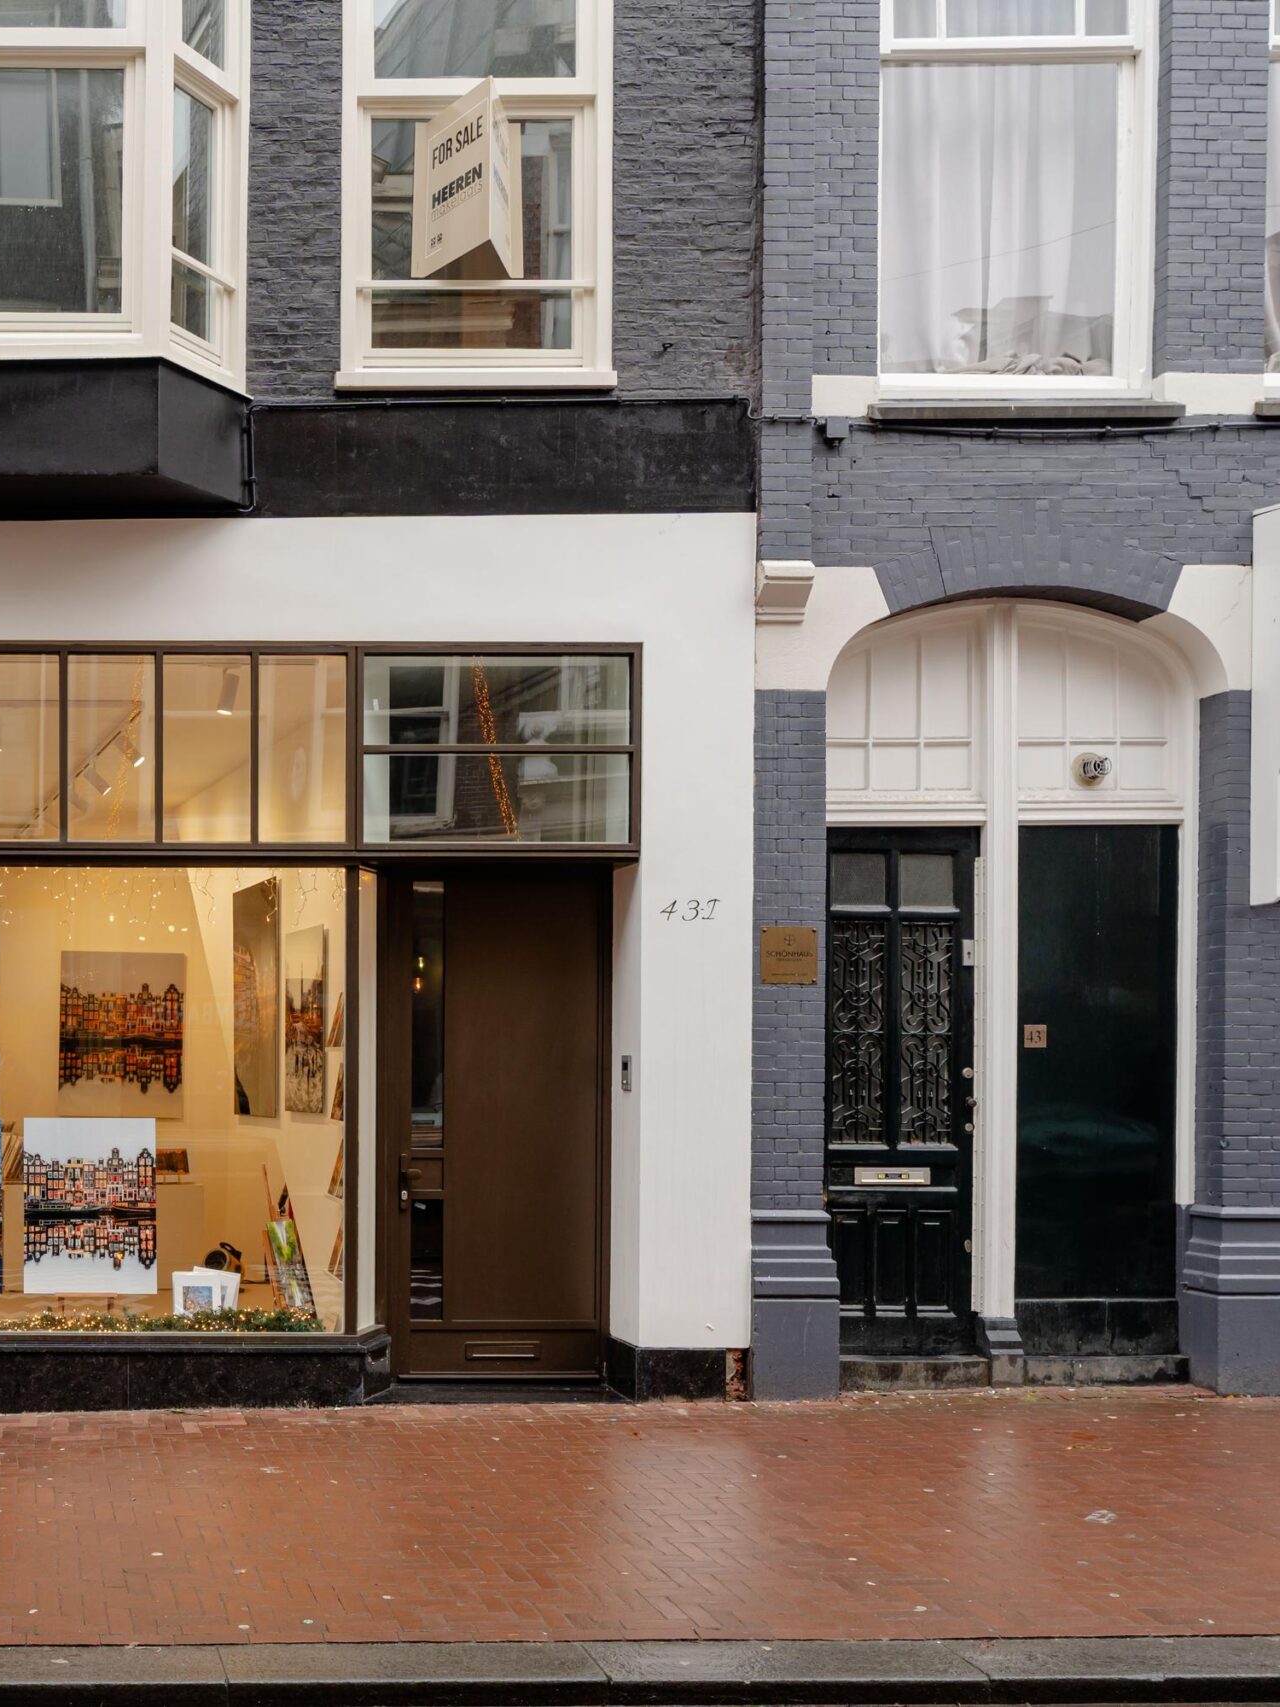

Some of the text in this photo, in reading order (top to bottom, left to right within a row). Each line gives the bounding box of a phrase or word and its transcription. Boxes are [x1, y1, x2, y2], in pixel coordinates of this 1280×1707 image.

[432, 137, 453, 170] FOR
[455, 115, 483, 153] SALE
[432, 162, 482, 210] HEEREN
[1025, 1030, 1042, 1044] 43
